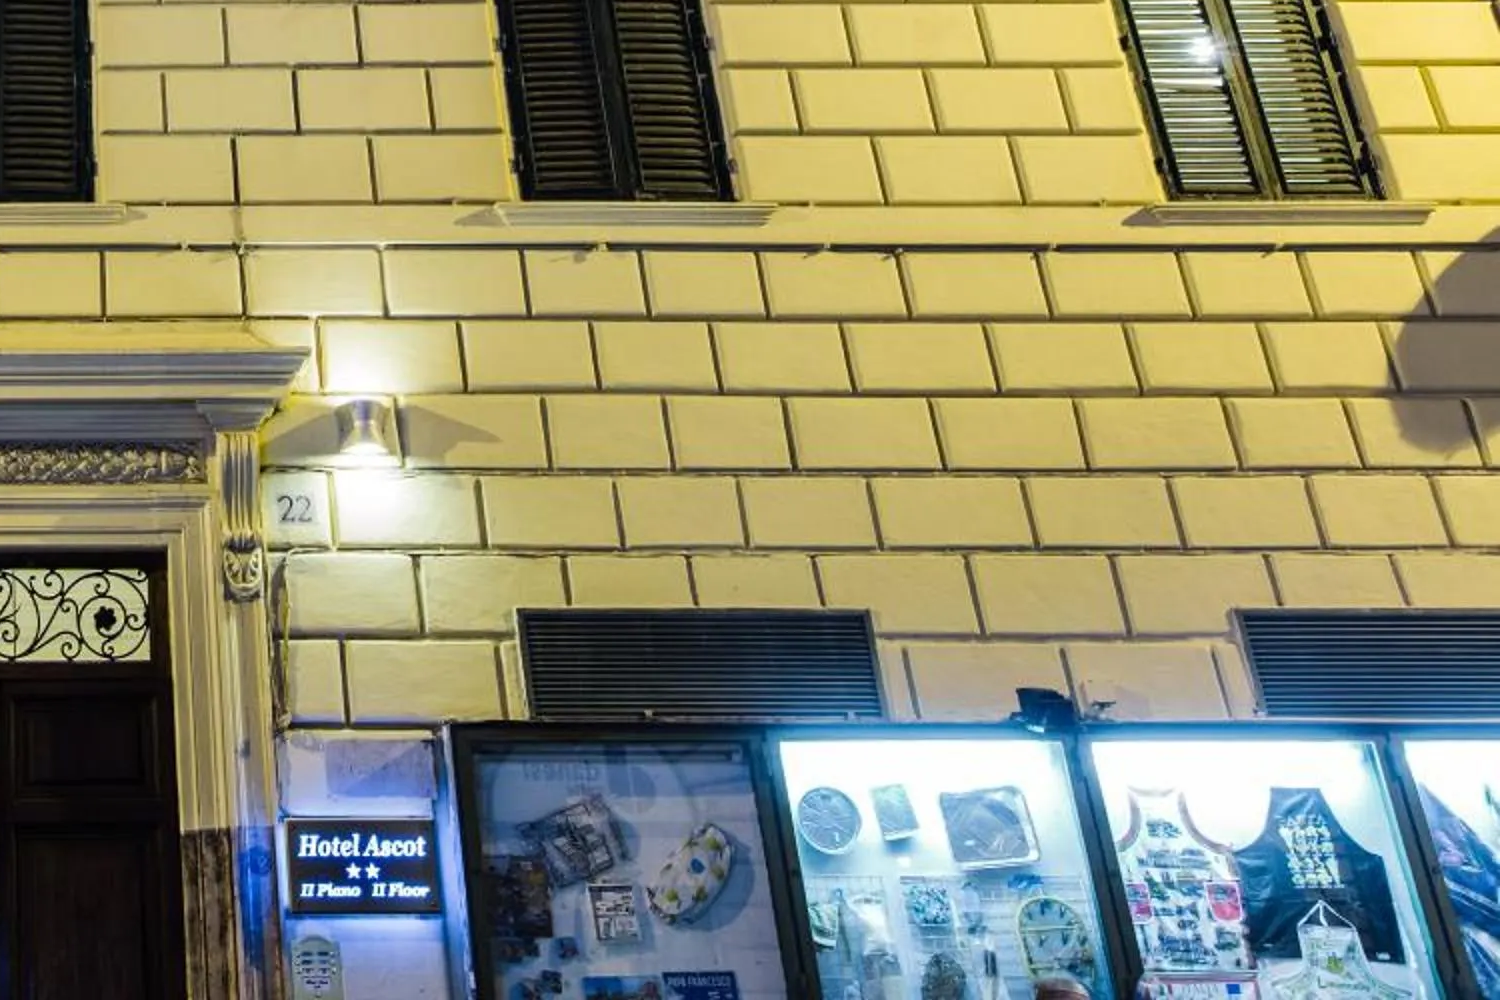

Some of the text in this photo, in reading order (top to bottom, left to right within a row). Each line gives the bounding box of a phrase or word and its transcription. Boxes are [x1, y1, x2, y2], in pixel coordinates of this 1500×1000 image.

[277, 495, 312, 522] 22
[298, 833, 427, 857] Hotel Ascot
[317, 882, 361, 897] Piano
[372, 883, 387, 897] II
[388, 882, 431, 898] Floor
